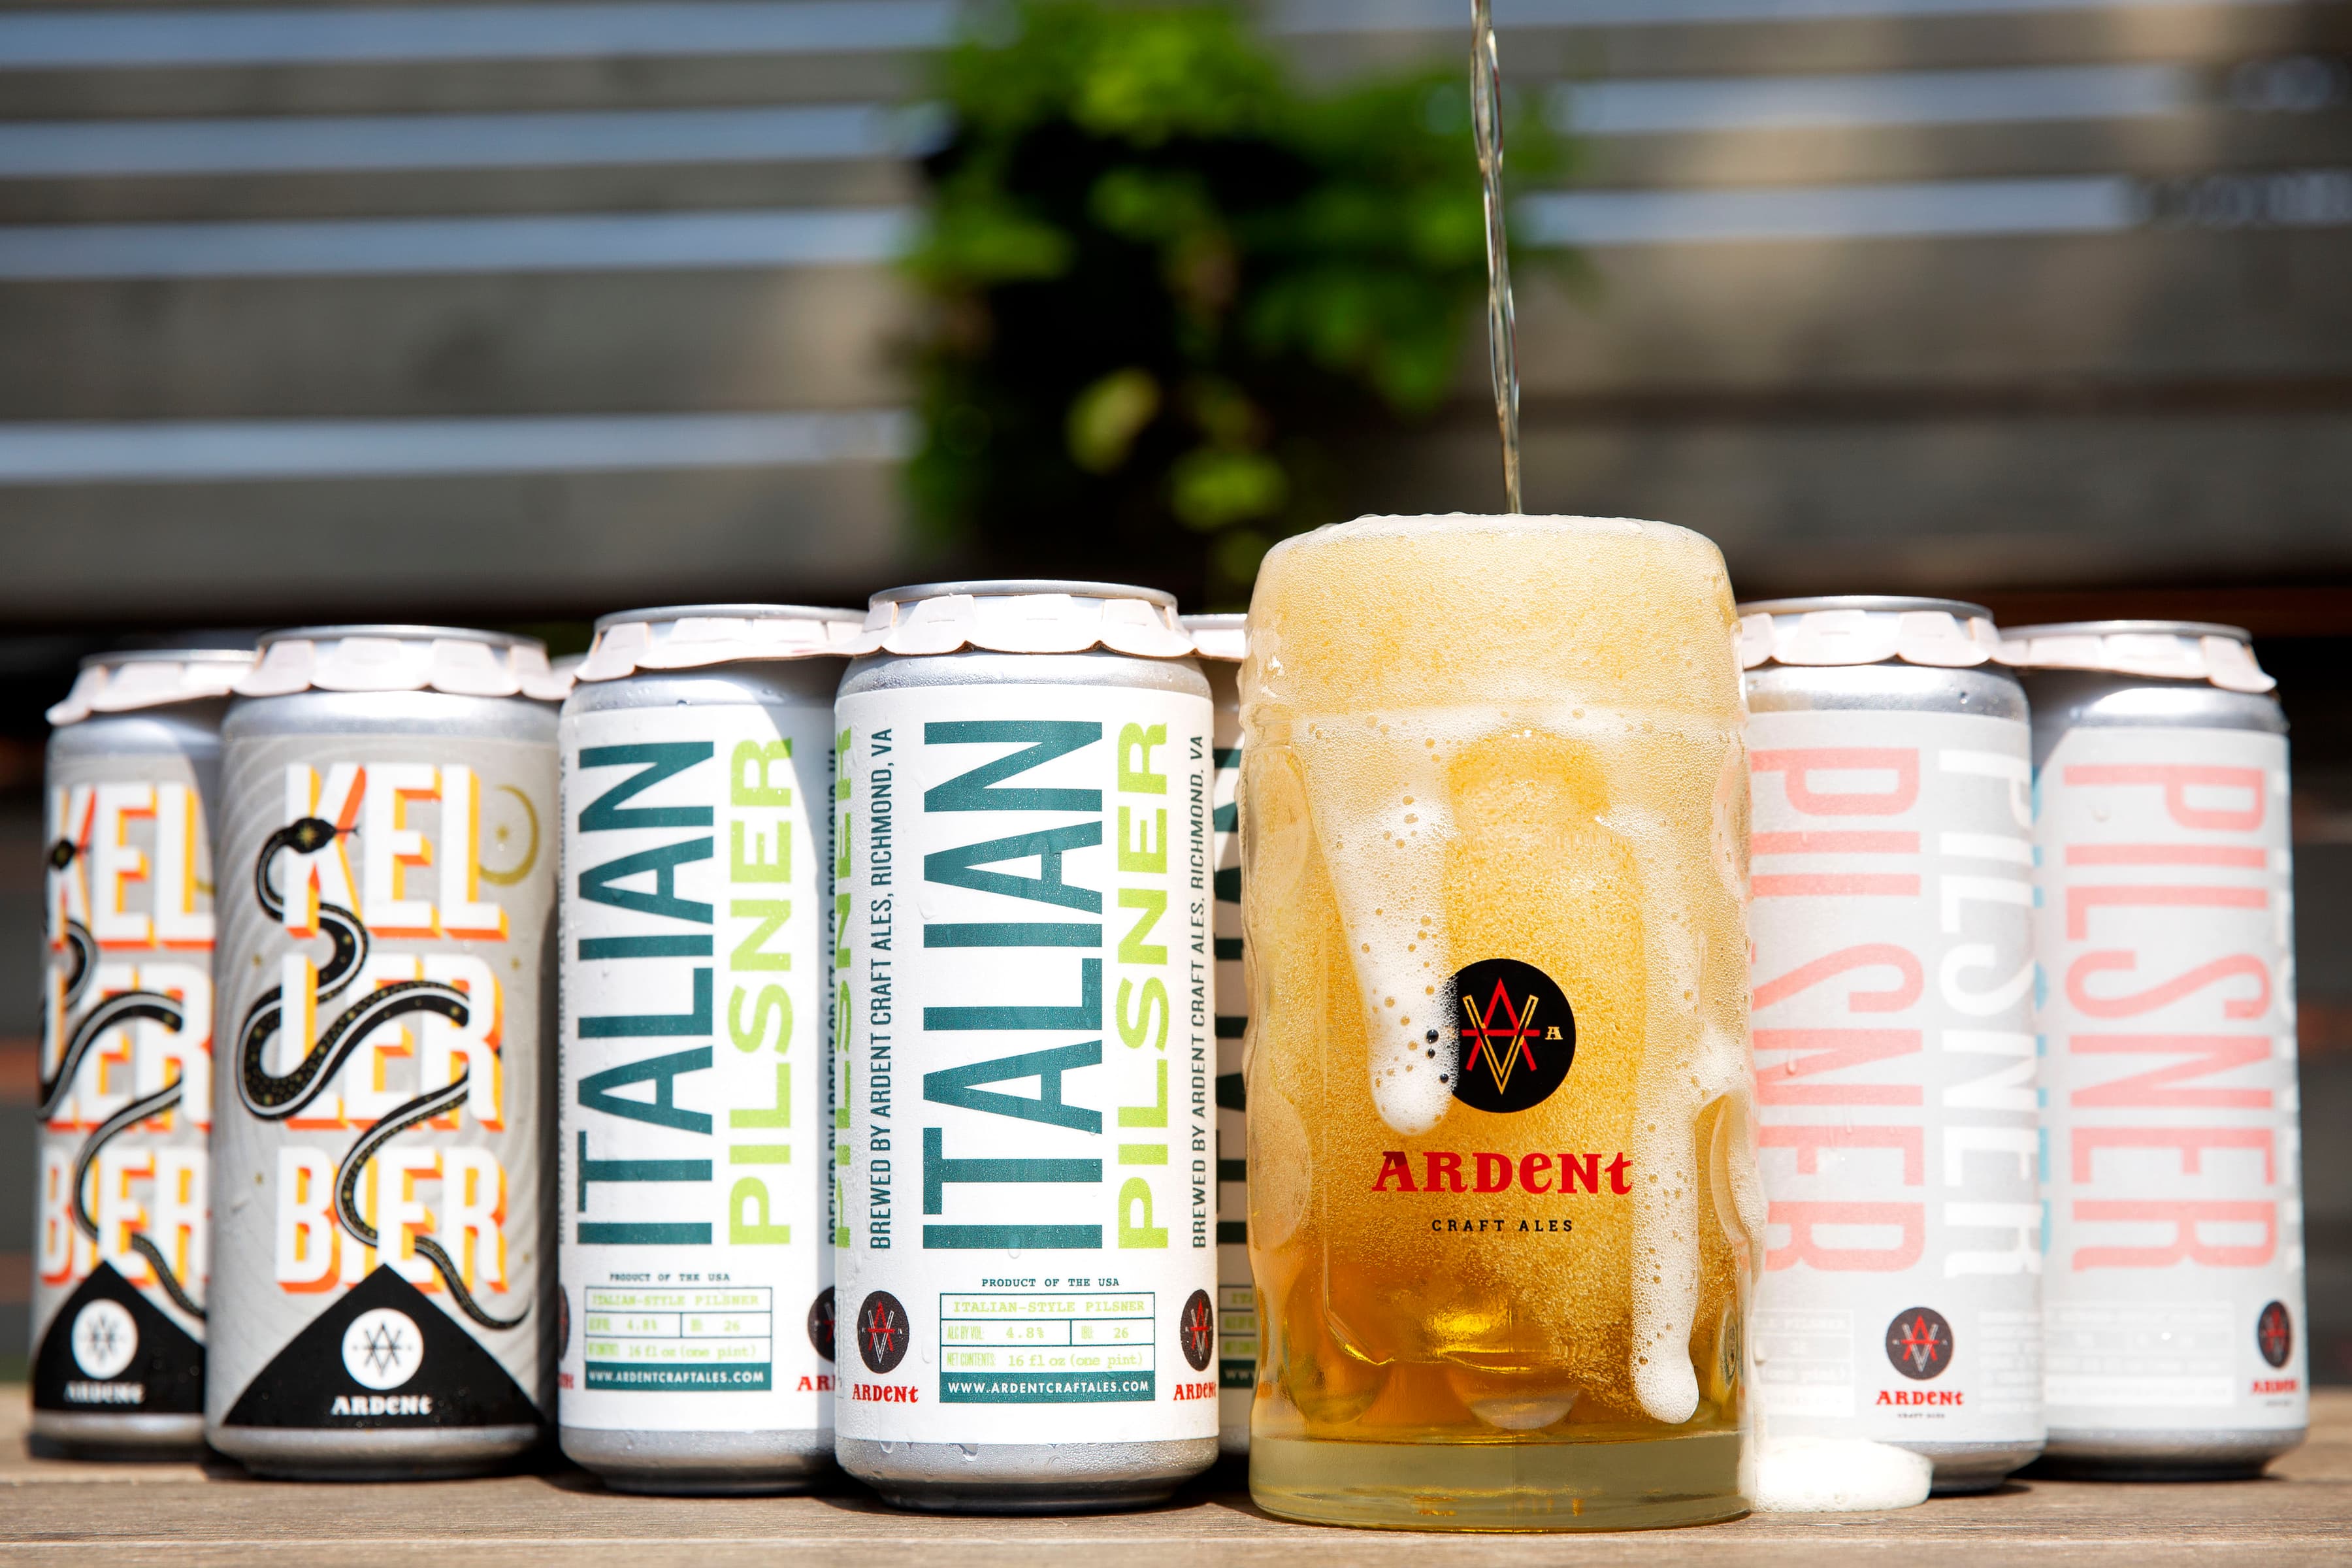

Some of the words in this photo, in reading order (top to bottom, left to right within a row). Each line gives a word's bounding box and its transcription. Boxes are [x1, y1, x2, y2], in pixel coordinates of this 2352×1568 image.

[871, 728, 892, 757] VA
[1190, 736, 1203, 760] VA
[284, 763, 509, 941] KEL
[871, 762, 894, 886] RICHMOND,
[48, 782, 216, 951] KEL
[871, 893, 894, 951] ALES,
[577, 742, 713, 1245] ITALIAN
[728, 736, 793, 1245] PILSNER
[871, 958, 891, 1025] CRAFT
[923, 720, 1103, 1250] ITALIAN
[1116, 722, 1169, 1249] PILSNER
[1191, 960, 1204, 1027] CRAFT
[2063, 764, 2279, 1272] PILSNER
[278, 953, 506, 1132] LER
[871, 1032, 891, 1118] ARDENT
[1191, 1034, 1205, 1118] ARDENT
[871, 1124, 890, 1151] BY
[1192, 1125, 1205, 1151] BY
[275, 1146, 510, 1294] BIER
[870, 1160, 890, 1249] BREWED
[1192, 1160, 1206, 1248] BREWED
[1431, 1219, 1505, 1232] CRAFT
[1519, 1219, 1573, 1232] ALES
[592, 1295, 685, 1306] ITALIAN-STYLE
[695, 1294, 759, 1305] PILSNER
[953, 1301, 1075, 1313] ITALIAN-STYLE
[1086, 1301, 1145, 1312] PILSNER
[982, 1279, 1036, 1287] PRODUCT
[1044, 1279, 1060, 1287] OF
[1098, 1278, 1119, 1286] USA
[724, 1320, 740, 1331] 26
[1006, 1327, 1045, 1339] 4.8%
[1113, 1327, 1129, 1339] 26
[589, 1371, 764, 1384] WWW.ARDENTCRAFTALES.COM
[947, 1380, 1149, 1394] WWW.ARDENTCRAFTALES.COM
[1008, 1355, 1024, 1367] 16
[1030, 1354, 1045, 1366] fl
[1049, 1357, 1066, 1366] oz
[1070, 1353, 1101, 1367] (one
[1107, 1352, 1143, 1369] pint)
